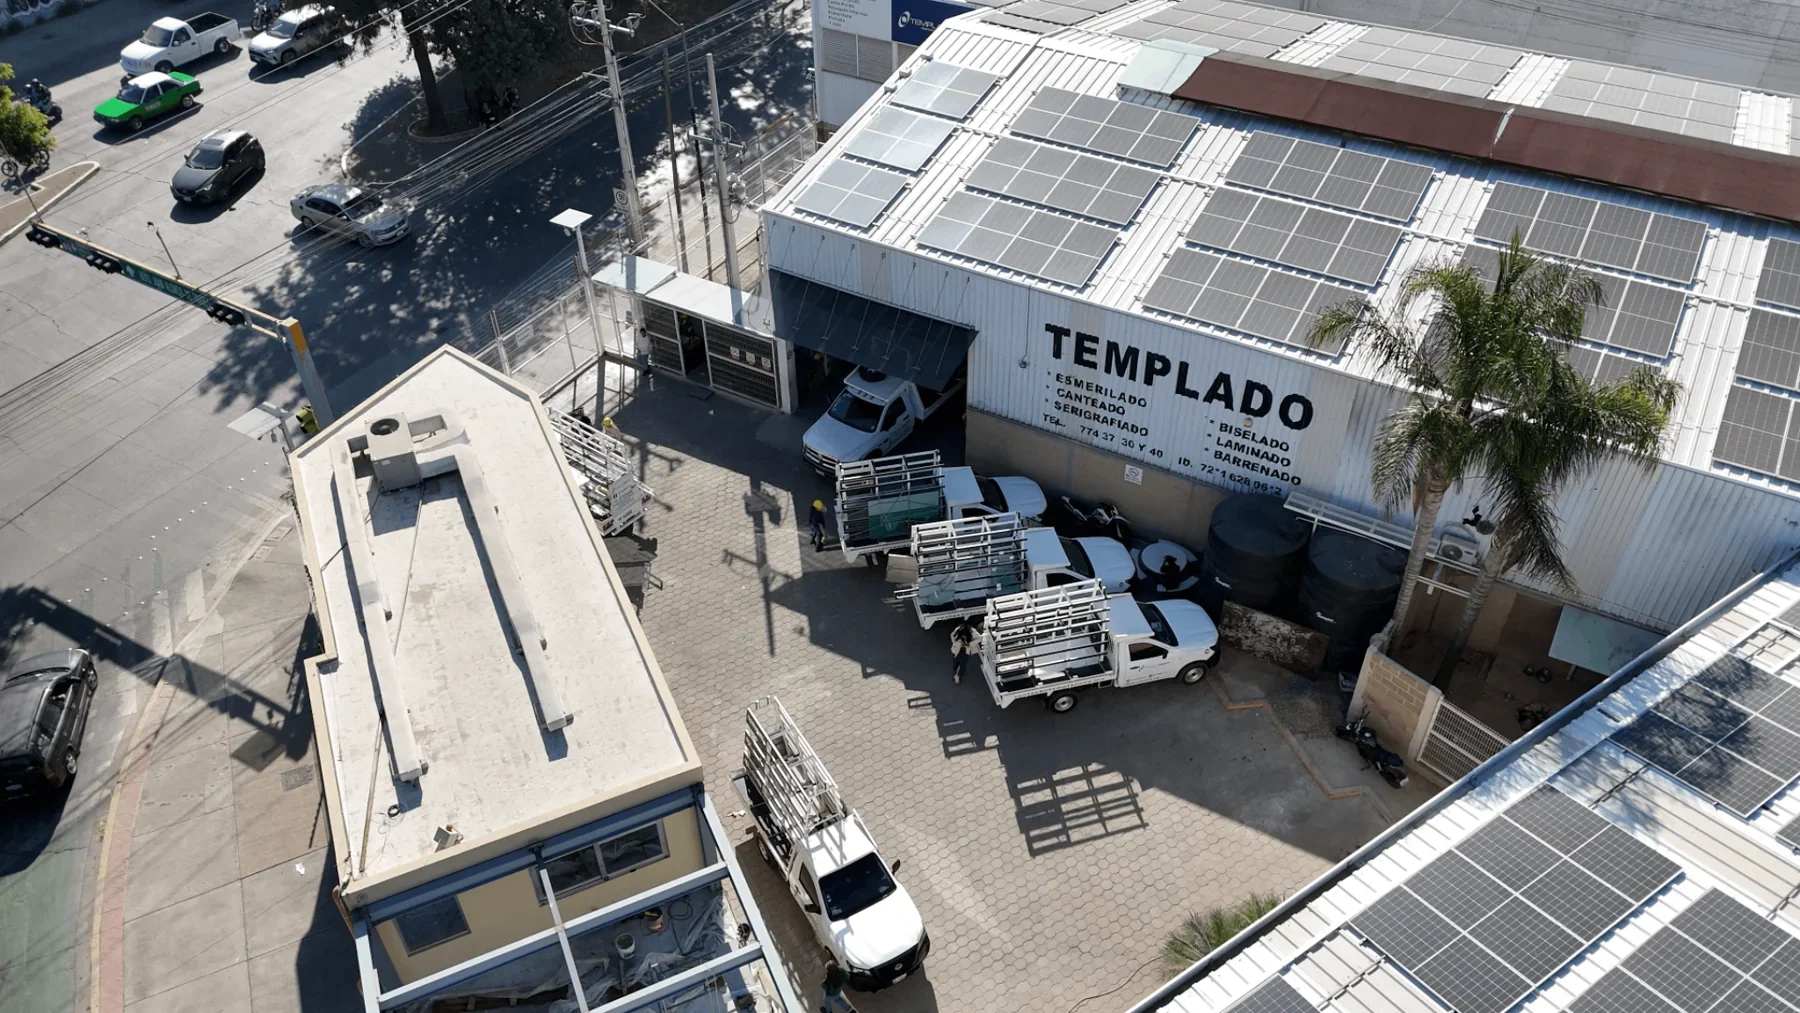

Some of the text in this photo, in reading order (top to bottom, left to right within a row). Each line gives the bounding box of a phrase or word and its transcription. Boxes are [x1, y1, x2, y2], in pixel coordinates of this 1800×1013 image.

[910, 18, 938, 29] TEMPL
[1045, 323, 1314, 430] TEMPLADO
[1055, 373, 1148, 408] ESMERILADO
[1053, 401, 1149, 437] SERIGRAFIADO
[1056, 388, 1126, 416] CANTEADO
[1080, 425, 1099, 438] 774
[1102, 432, 1116, 442] 37
[1121, 438, 1135, 449] 30
[1138, 443, 1147, 452] Y
[1149, 448, 1164, 459] 40
[1216, 436, 1291, 467] LAMINADO
[1219, 422, 1290, 452] BISELADO
[1213, 450, 1302, 486] BARRENADO
